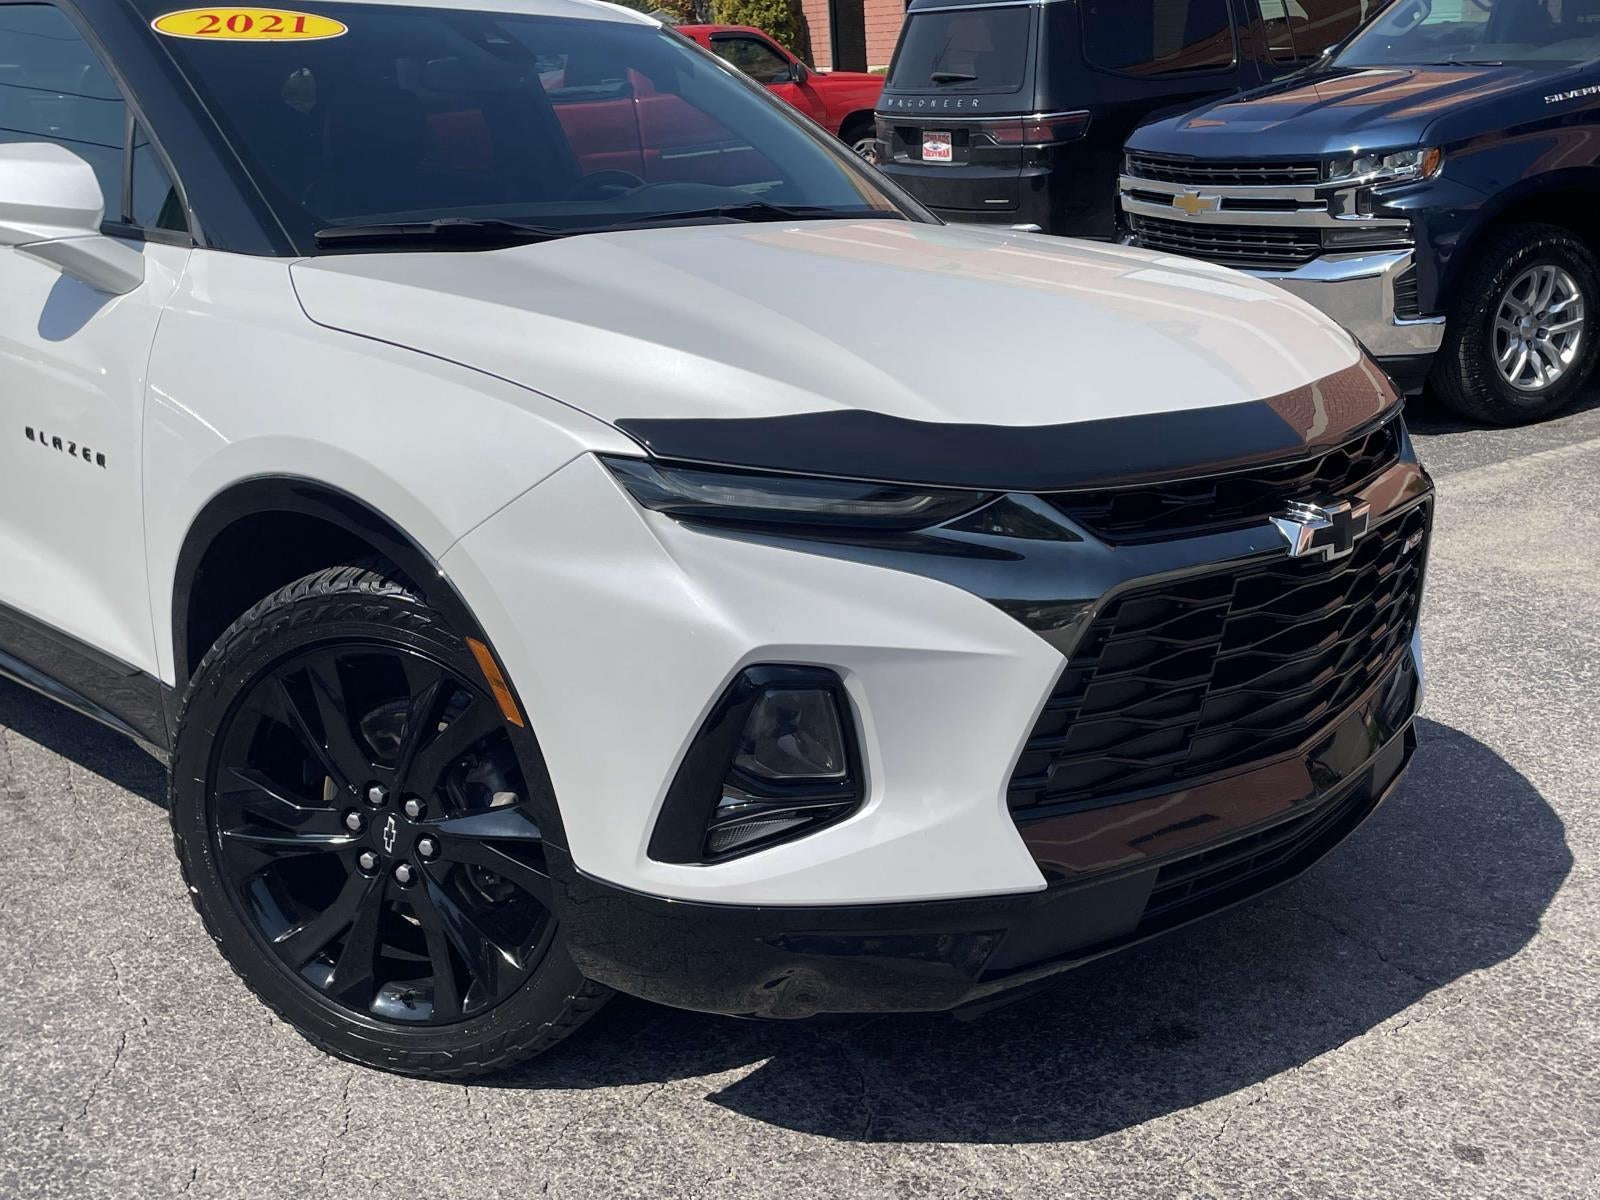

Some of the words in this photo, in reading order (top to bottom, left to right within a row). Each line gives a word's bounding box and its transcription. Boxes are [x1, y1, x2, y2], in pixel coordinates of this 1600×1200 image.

[195, 14, 310, 35] 2021
[887, 98, 980, 108] WAGONEER
[25, 426, 106, 469] BLAZER
